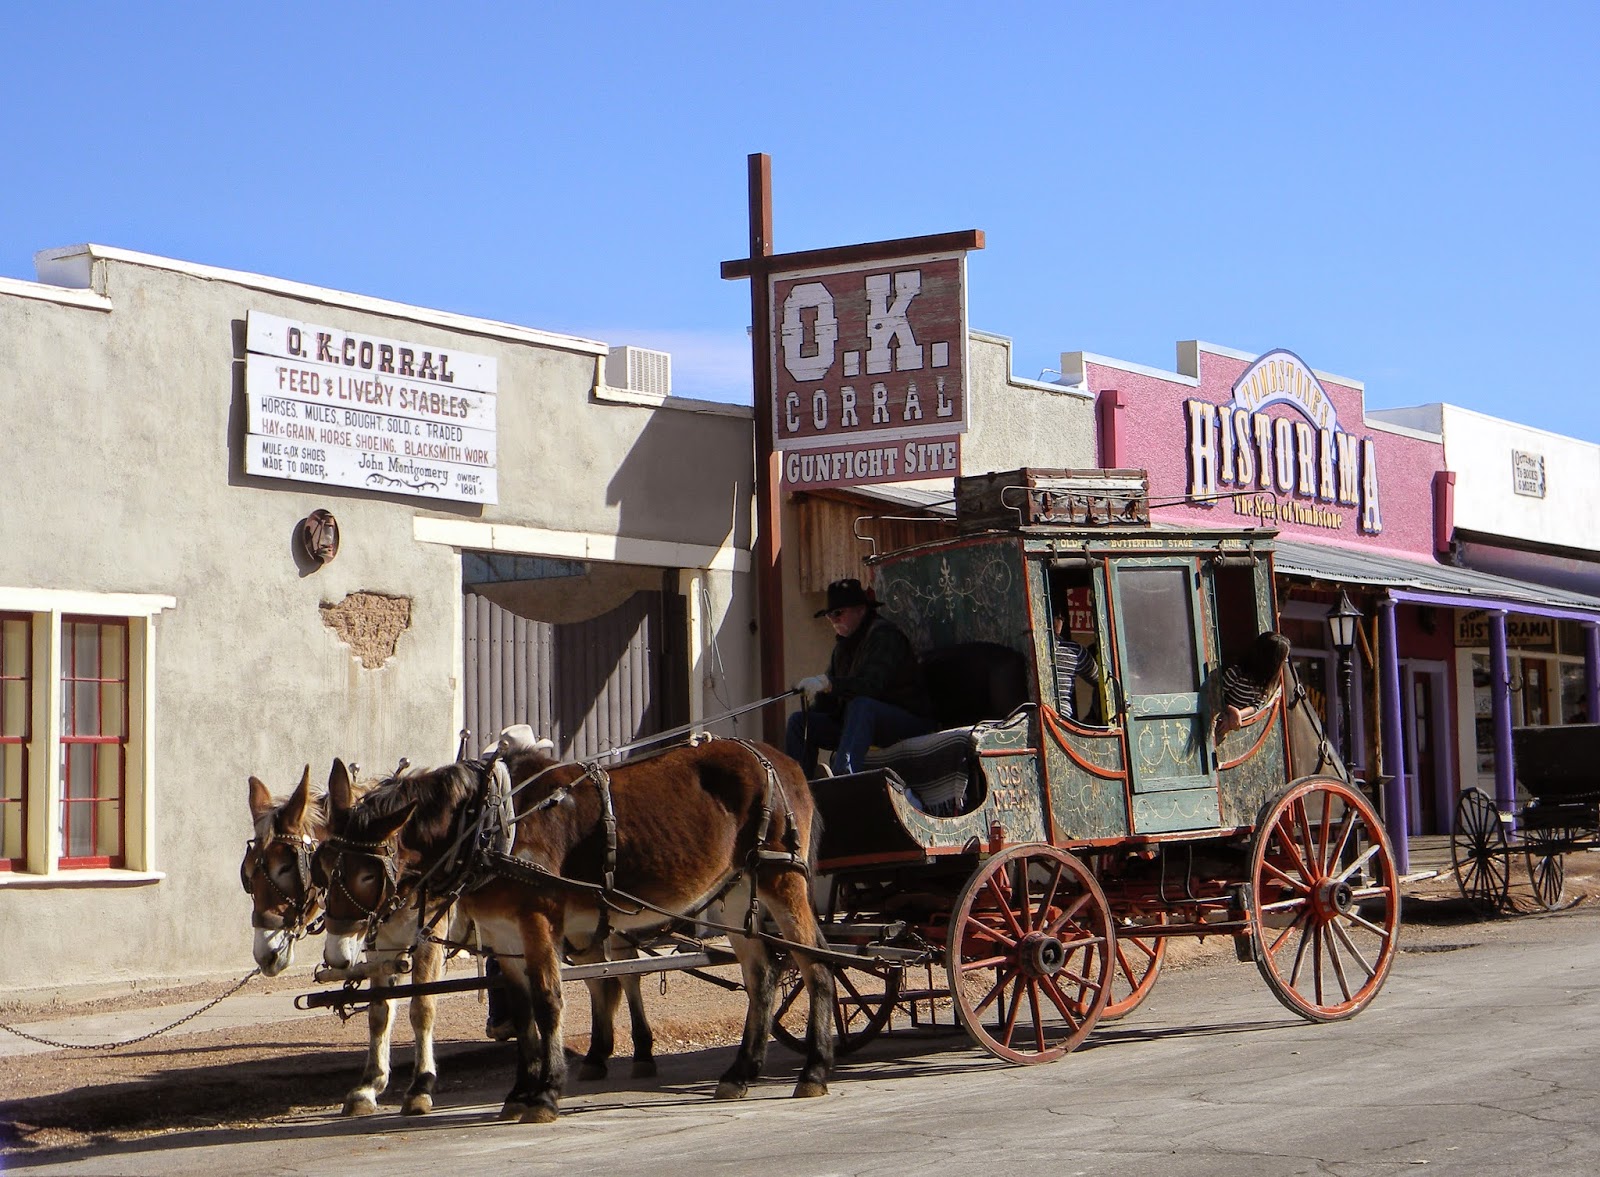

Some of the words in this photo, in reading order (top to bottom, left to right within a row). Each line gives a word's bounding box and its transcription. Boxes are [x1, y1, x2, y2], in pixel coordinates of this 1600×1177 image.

[780, 269, 949, 383] O.K.
[279, 367, 320, 396] FEED
[325, 377, 334, 397] &
[338, 376, 394, 407] LIVERY
[399, 387, 468, 419] STABLES
[786, 376, 953, 433] CORRAL
[320, 428, 352, 447] HORSE
[404, 441, 461, 461] BLACKSMITH
[464, 447, 489, 465] WORK
[414, 425, 421, 436] &
[426, 423, 463, 442] TRADED
[262, 442, 282, 456] MULE
[301, 448, 326, 462] SHOES
[262, 457, 283, 471] MADE
[287, 460, 297, 473] TO
[786, 448, 898, 484] GUNFIGHT
[904, 441, 957, 474] SITE
[1186, 398, 1383, 535] HISTORAMA
[358, 453, 384, 471] John
[388, 456, 449, 486] Montgomery
[461, 483, 477, 496] 1881
[1234, 494, 1253, 516] The
[1255, 495, 1281, 525] Story
[1282, 501, 1293, 523] of
[1293, 502, 1342, 529] Tombstone
[1110, 539, 1163, 548] BUTTERFIELD
[1168, 539, 1194, 548] STAGE
[1223, 539, 1242, 548] LINE
[1459, 622, 1550, 639] HISRAMA
